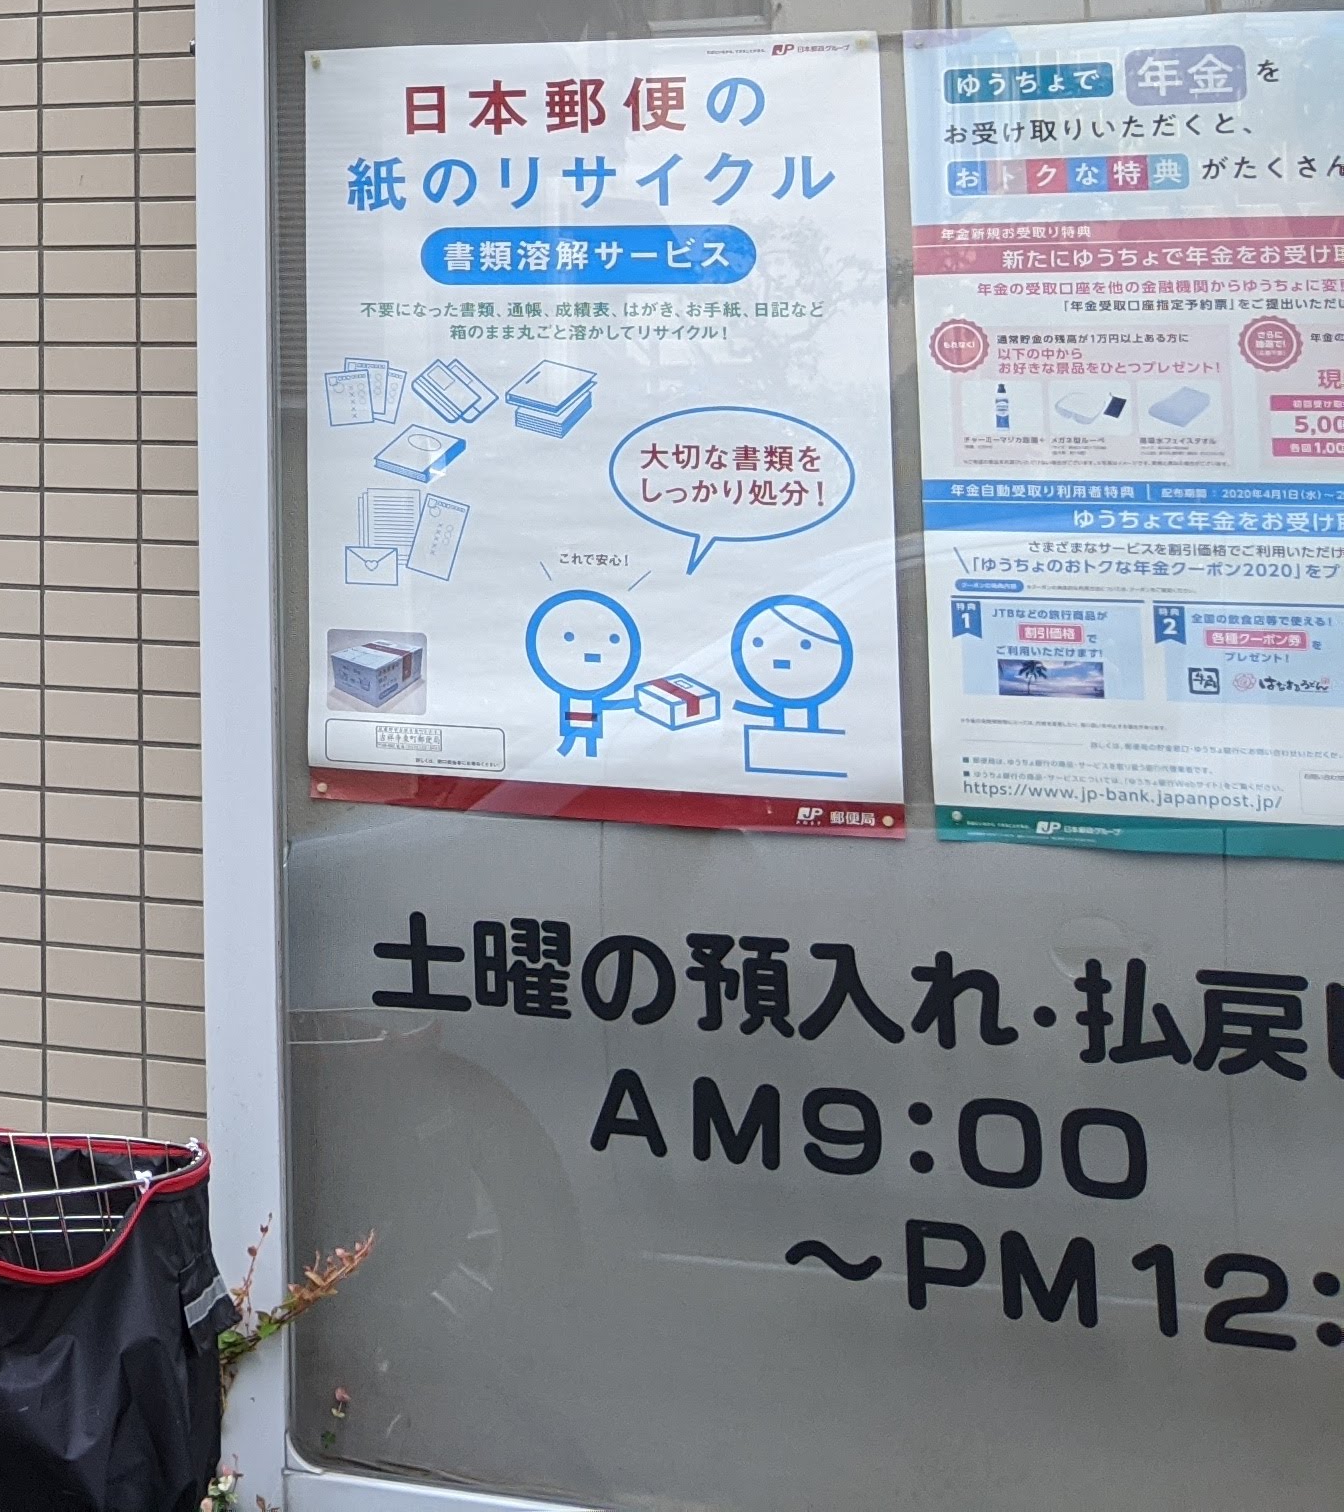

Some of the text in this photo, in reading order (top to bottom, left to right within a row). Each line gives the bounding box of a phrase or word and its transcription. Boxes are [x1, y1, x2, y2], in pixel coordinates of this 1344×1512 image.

[957, 53, 1280, 97] ゆうちょで 年金 を
[405, 76, 767, 136] 日本郵便の
[944, 112, 1254, 146] お受け取りいただくと、
[348, 154, 837, 212] 紙のリサイクル
[955, 159, 1182, 189] おトクな特典
[941, 226, 1091, 240] 年金新規お受取り特典
[443, 238, 731, 272] 書類溶解サービス
[977, 278, 1344, 296] 年金の受取口座を他の金融機関からゆうちょに変
[360, 300, 825, 320] 不要になった書類、通帳、成績表、はがき、お手紙、日記など
[449, 323, 728, 342] 箱のまま丸ごと溶かしてリサイクル！
[996, 332, 1189, 345] 通常貯金の残高が1万円以上ある方に
[997, 347, 1083, 361] 以下の中から
[998, 360, 1221, 375] お好きな景品をひとつプレゼント！
[1294, 415, 1344, 436] 5,00
[640, 443, 822, 474] 大切な書類を
[642, 478, 827, 509] しっかり処分！
[951, 484, 1135, 499] 年金自動受取り利用者特典
[1028, 541, 1344, 559] さまざまなサービスを割引価格でご利用いただけ
[559, 552, 629, 568] これで安心！
[972, 558, 1340, 579] 「ゆうちょのおトクな年金クーポン2020」をプ
[962, 613, 970, 629] 1
[992, 608, 1108, 621] JTBなどの旅行商品が
[1192, 614, 1333, 627] 全国の飲食店等で使える！
[1025, 627, 1097, 644] 割引価格 で
[1163, 618, 1177, 635] 2
[1212, 632, 1302, 647] 各種クーポン券
[996, 645, 1103, 658] ご利用いただけます！
[1225, 652, 1290, 663] プレゼント！
[963, 781, 1283, 811] https://www.jp-bank.japanpost.jp/
[829, 811, 875, 828] 郵便局
[589, 1068, 1149, 1199] AM9:00
